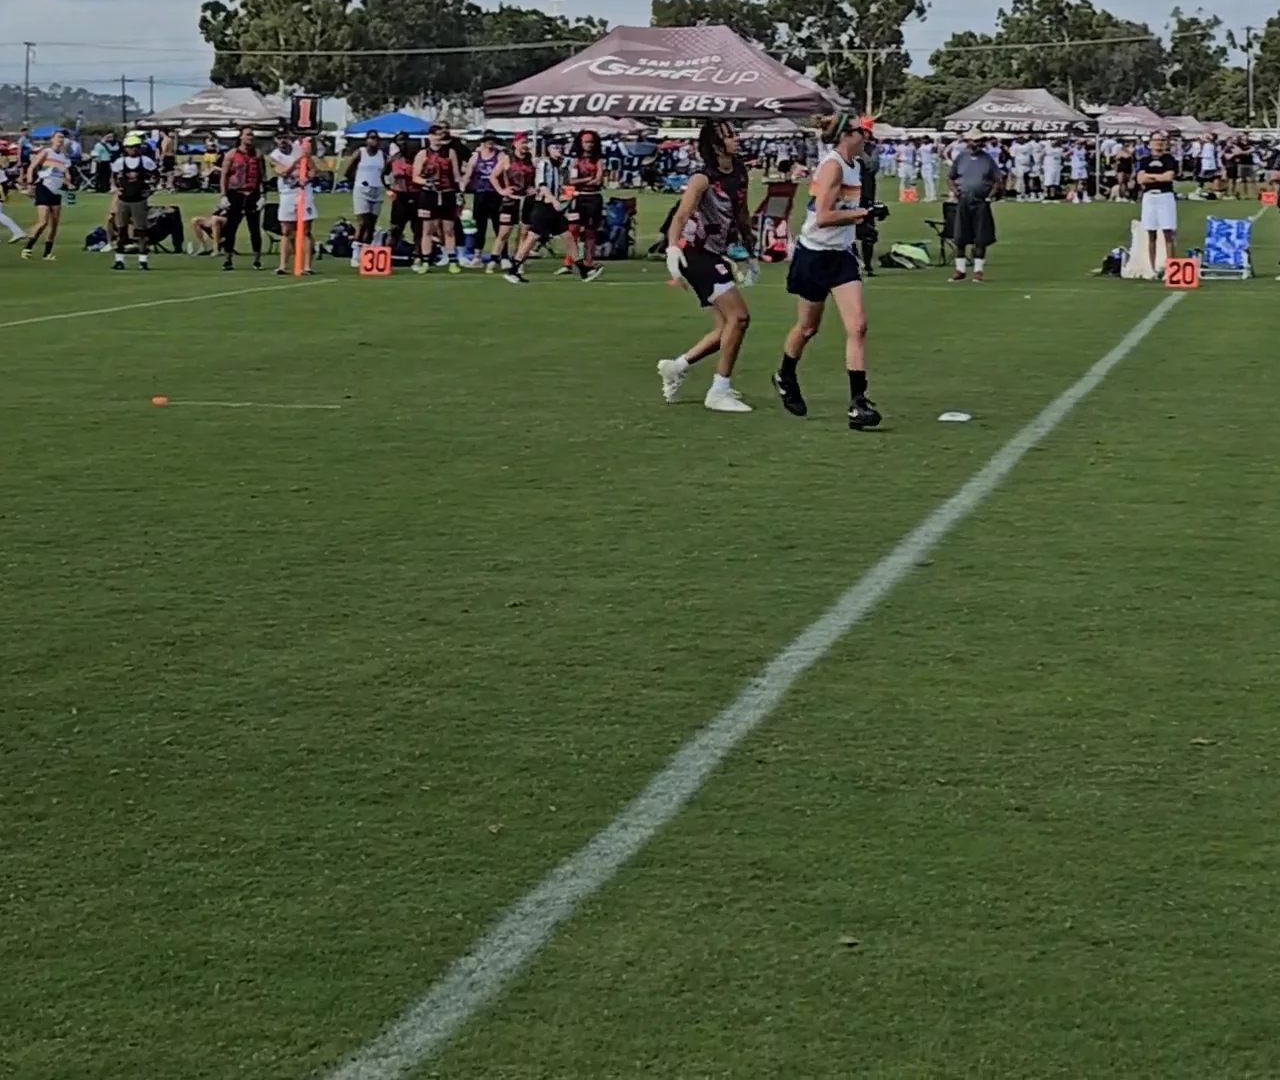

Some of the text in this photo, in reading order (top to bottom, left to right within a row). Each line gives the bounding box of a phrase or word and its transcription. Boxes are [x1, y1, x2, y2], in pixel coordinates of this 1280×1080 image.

[637, 55, 722, 67] SAN DIEGO
[590, 62, 761, 85] SURFCUP
[297, 99, 312, 128] 1
[519, 93, 747, 115] BEST OF THE BEST
[943, 120, 1070, 132] BEST OF THE BEST
[363, 250, 388, 273] 30
[1169, 261, 1195, 285] 20
